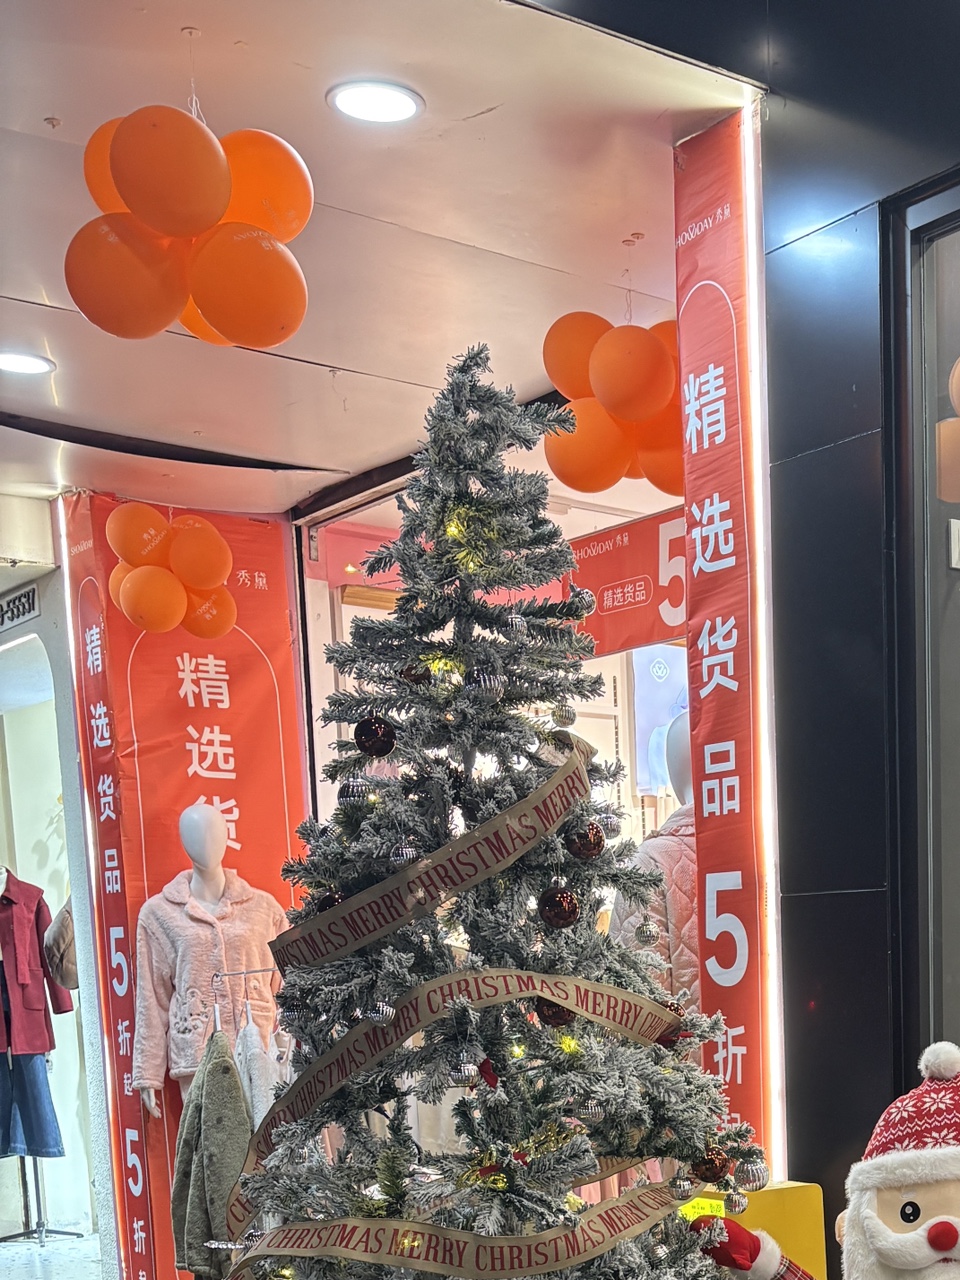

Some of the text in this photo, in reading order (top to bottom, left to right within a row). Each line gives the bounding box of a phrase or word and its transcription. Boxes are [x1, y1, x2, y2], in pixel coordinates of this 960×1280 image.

[675, 214, 714, 249] HOWDAY
[603, 581, 646, 610] 精选货品
[340, 887, 409, 942] MERRY
[406, 812, 538, 907] CHRISTMAS
[533, 766, 589, 833] MERRY
[293, 1038, 367, 1119] CHRISTMAS
[363, 996, 421, 1056] MERRY
[426, 974, 569, 1015] CHRISTMAS
[573, 983, 644, 1032] MERRY
[266, 1223, 386, 1254] CHRISTMAS
[386, 1228, 470, 1269] MERRY
[475, 1221, 605, 1272] CHRISTMAS
[599, 1200, 650, 1239] MERRY
